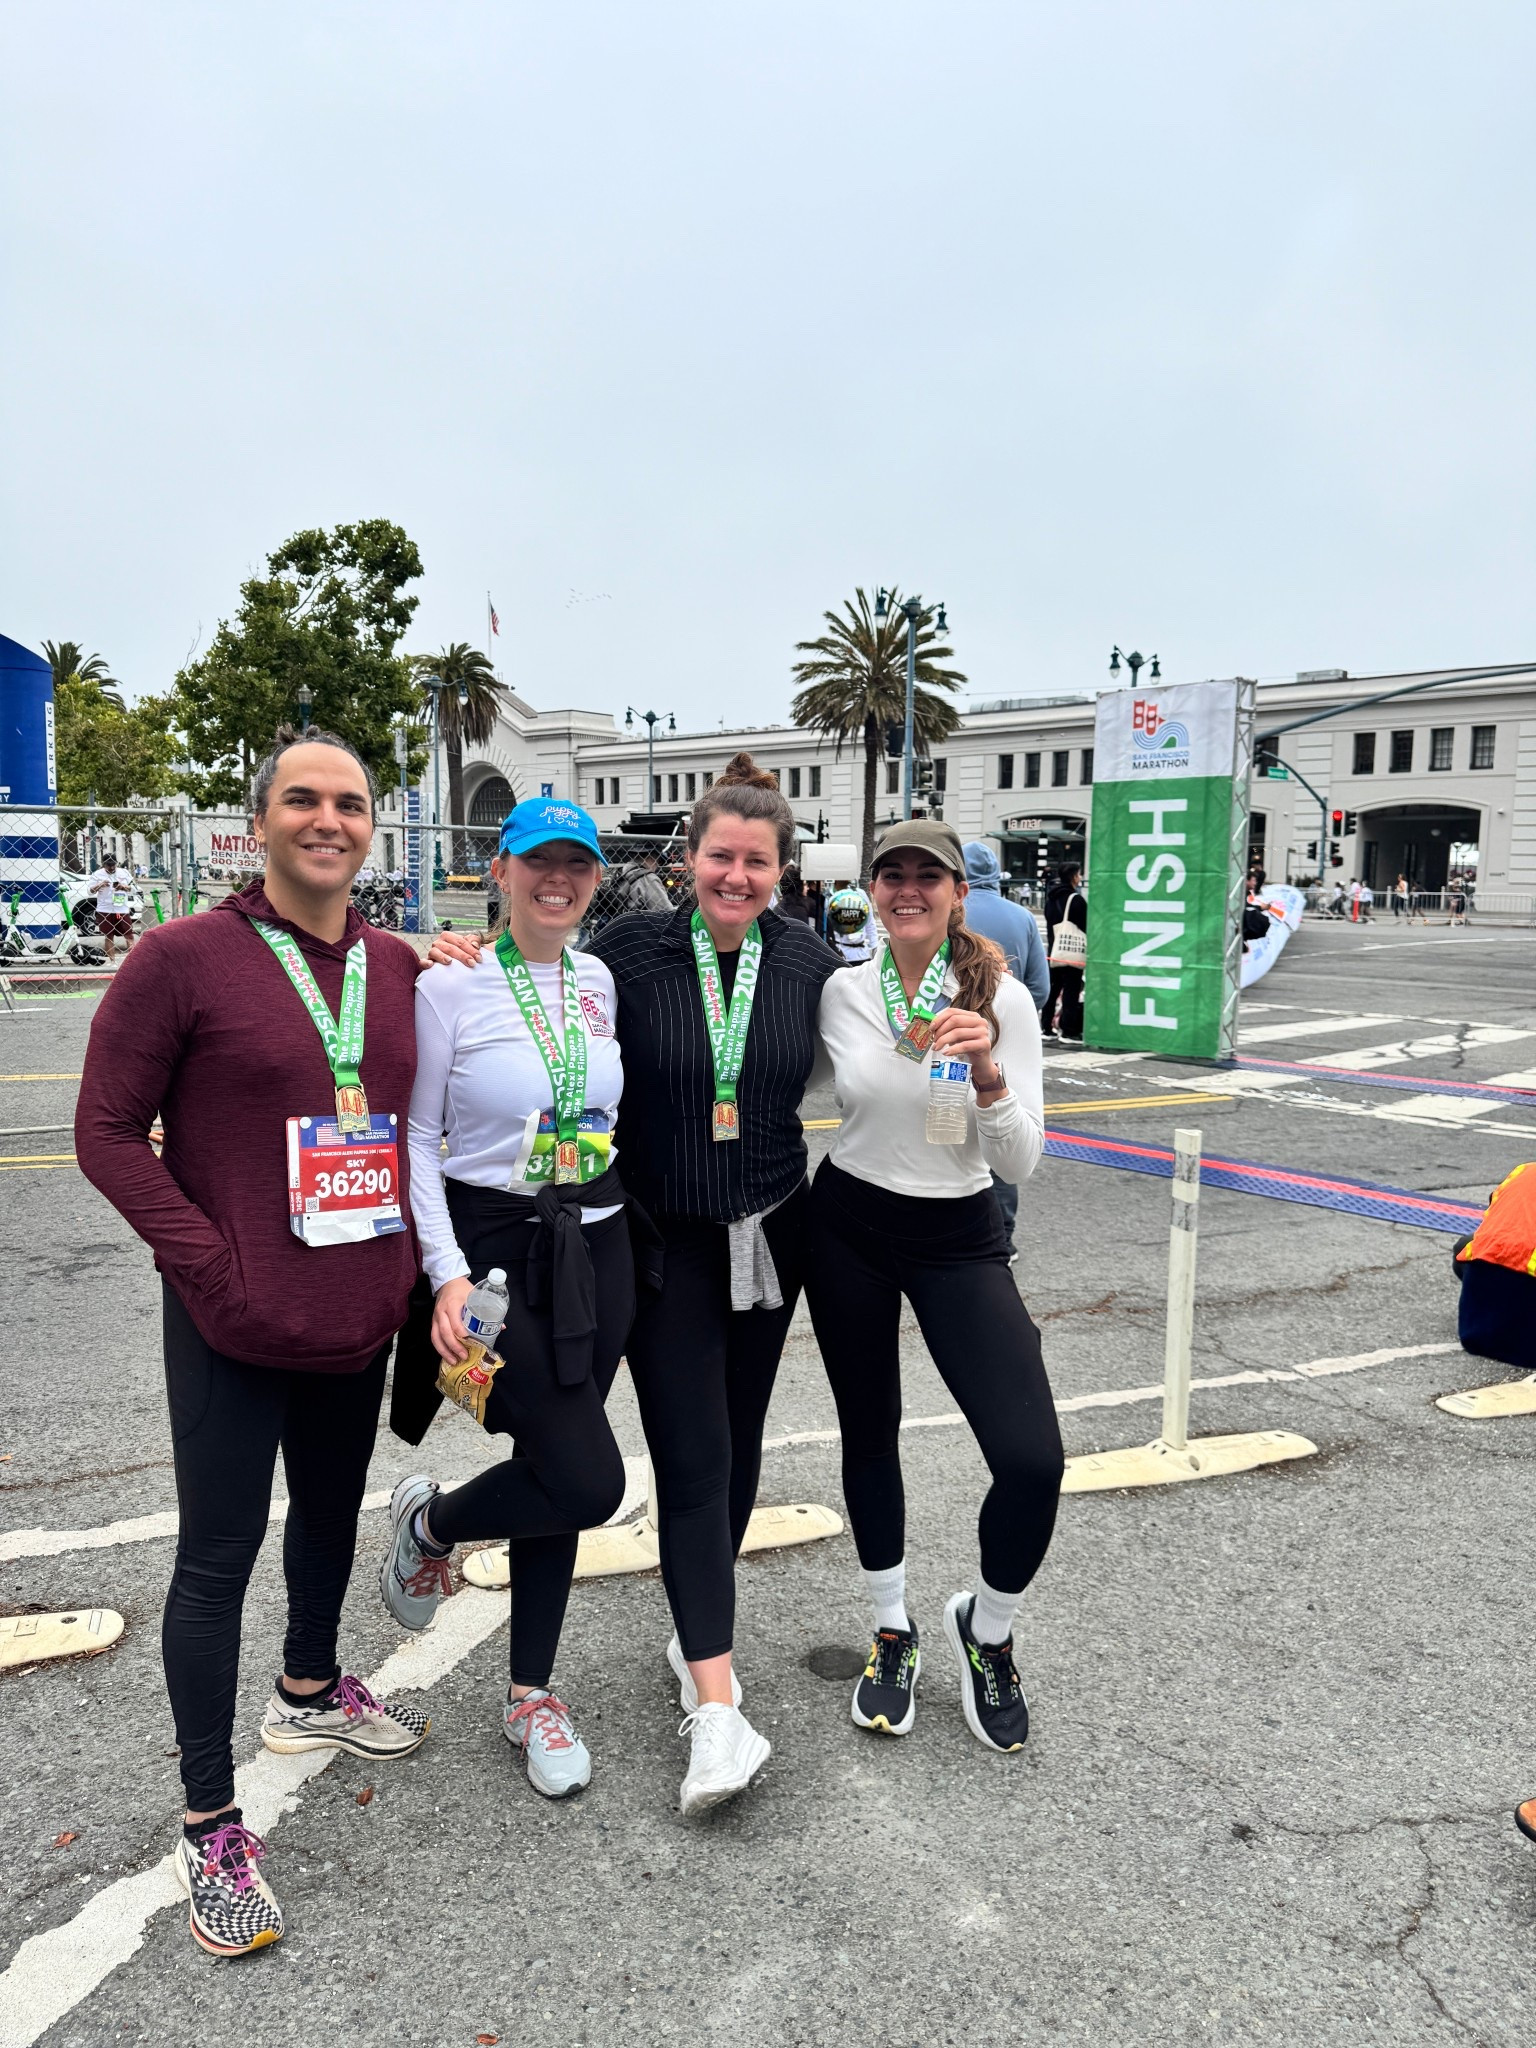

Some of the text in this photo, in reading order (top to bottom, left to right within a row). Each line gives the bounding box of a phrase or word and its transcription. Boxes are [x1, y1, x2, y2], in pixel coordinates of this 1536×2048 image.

[46, 706, 55, 785] PARKING
[1132, 759, 1189, 770] MARATHON
[1149, 750, 1190, 760] FRANCISCO
[540, 805, 581, 820] puppy
[1007, 817, 1043, 830] la mar
[841, 909, 861, 918] HAPPY
[1118, 798, 1188, 1031] FINISH
[692, 928, 715, 964] SAN
[285, 952, 318, 1003] MARATHON
[506, 964, 537, 1003] SAN
[733, 937, 763, 1001] 2025
[881, 967, 900, 1002] SAN
[911, 952, 947, 1014] 2025
[563, 968, 584, 1033] 2025
[706, 974, 722, 1022] MARATHON
[338, 980, 358, 1063] The Alexi Pappas
[350, 981, 365, 1064] SFM 10K Finisher
[532, 1013, 558, 1060] MARATHON
[719, 1001, 742, 1082] The Alexi Pappas
[729, 1001, 751, 1082] SFM 10K Finisher
[563, 1034, 578, 1119] The Alexi Pappas
[576, 1074, 584, 1094] 10K
[572, 1097, 583, 1118] SFM
[314, 1167, 391, 1199] 36290
[346, 1158, 366, 1168] SKY
[473, 1368, 485, 1381] Mini
